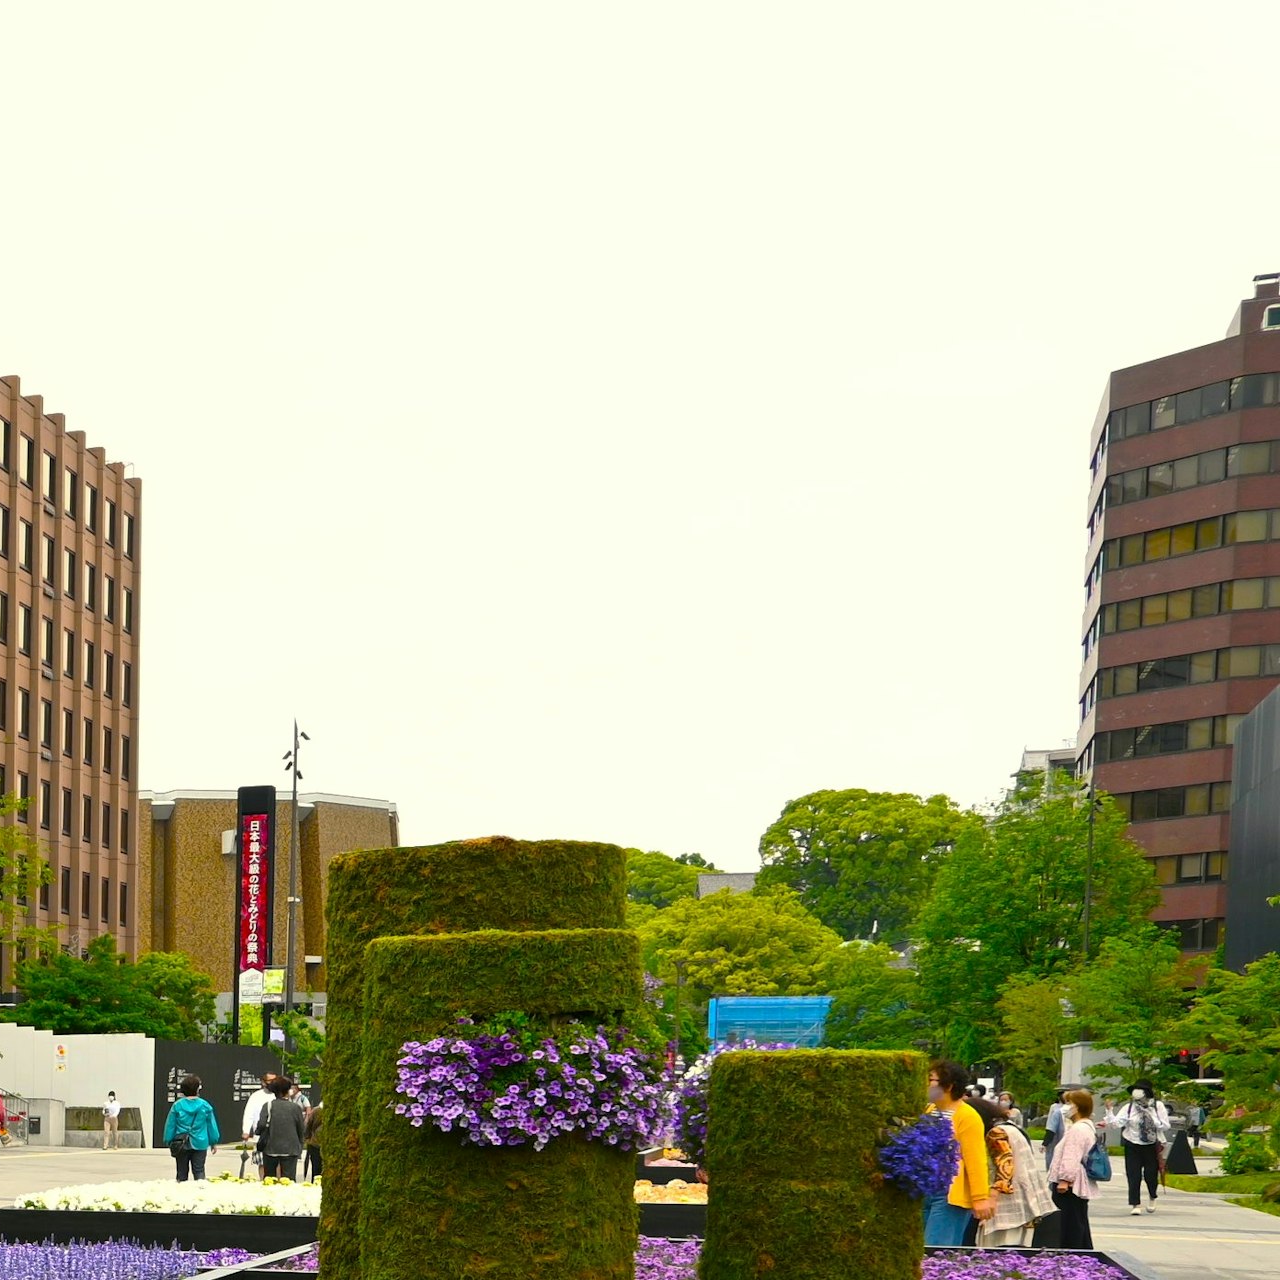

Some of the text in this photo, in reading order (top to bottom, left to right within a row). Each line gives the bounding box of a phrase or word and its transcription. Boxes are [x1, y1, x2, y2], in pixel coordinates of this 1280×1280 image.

[246, 820, 261, 964] 日本最大級の花とみどりの祭典
